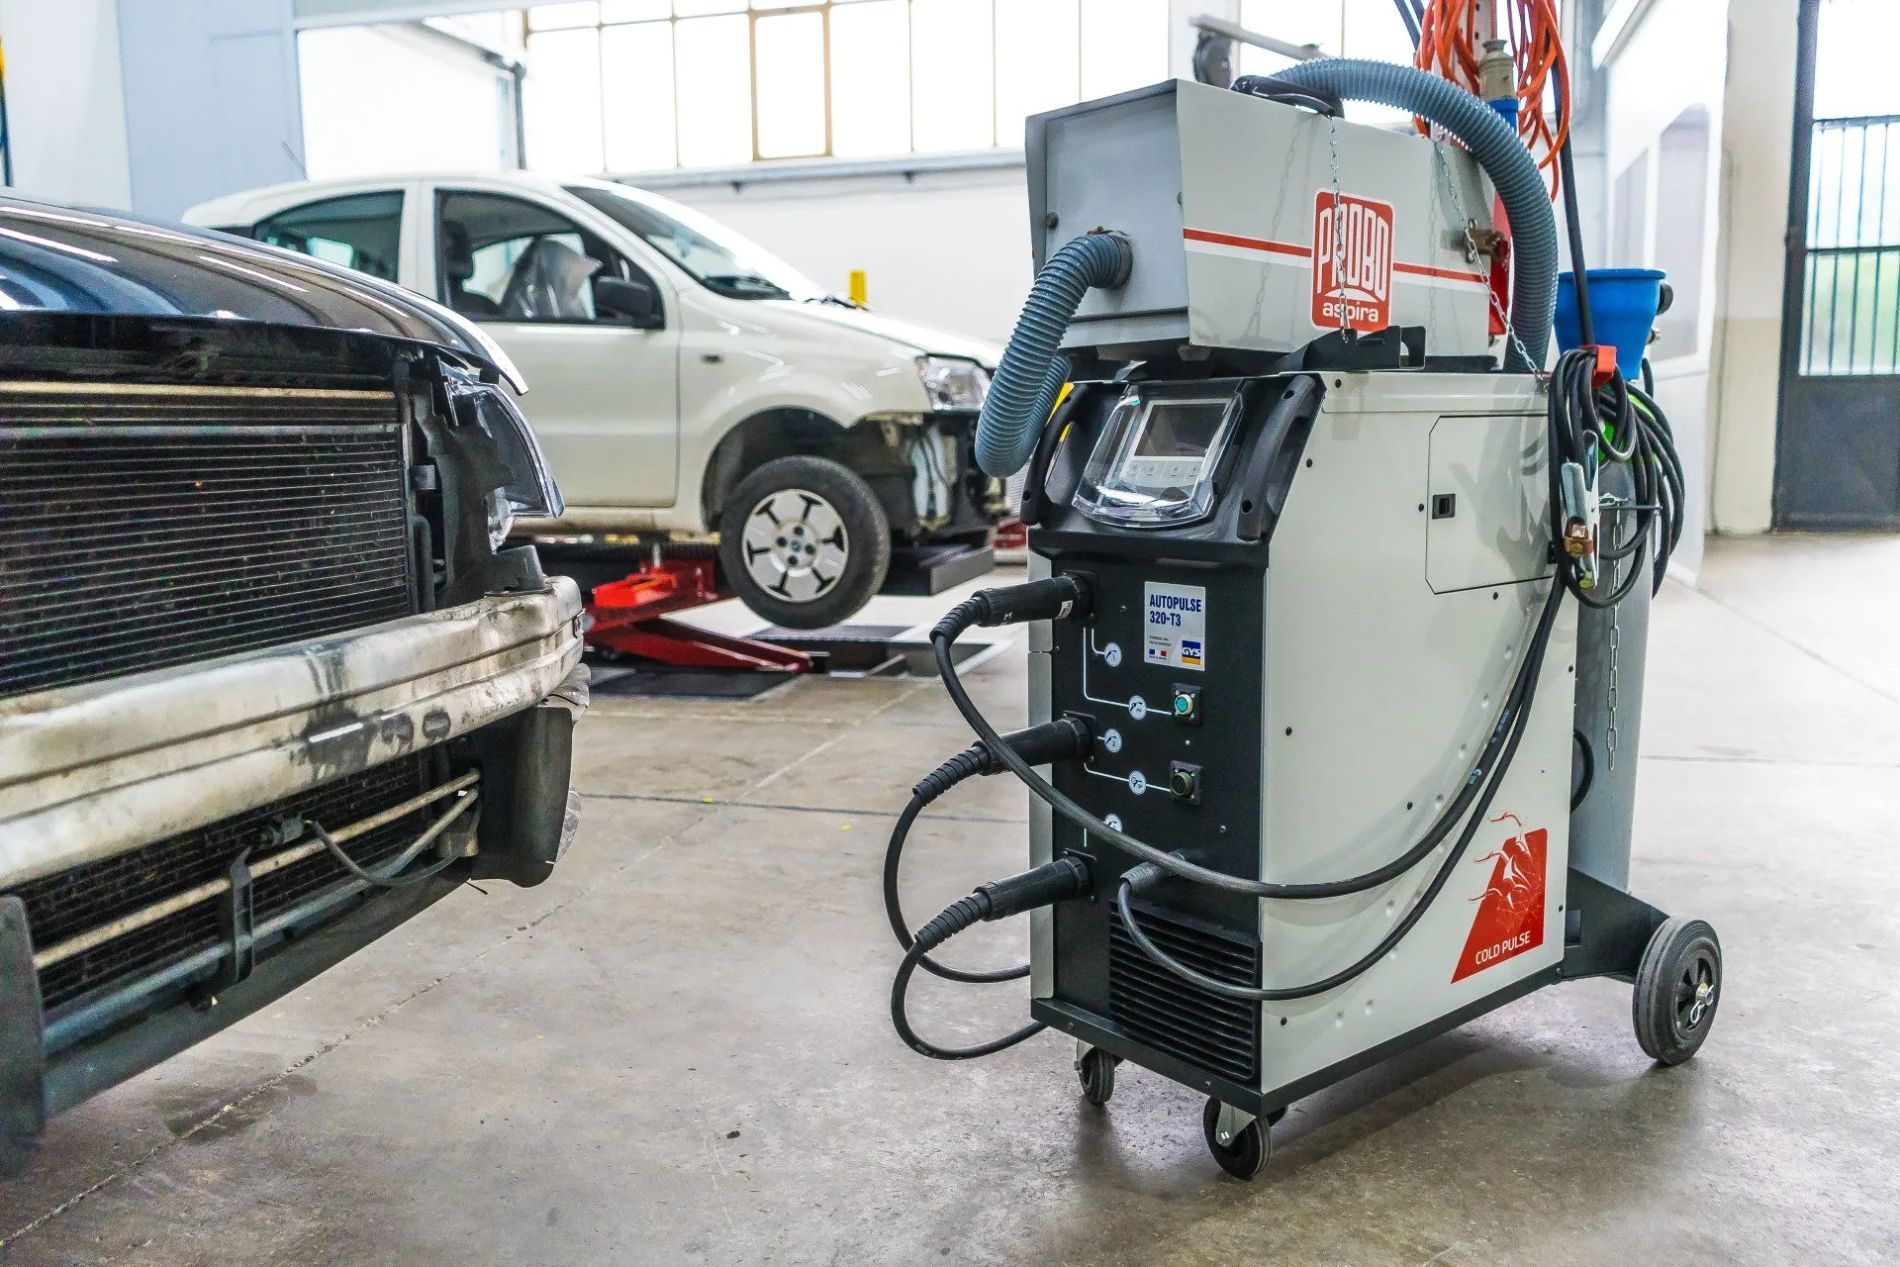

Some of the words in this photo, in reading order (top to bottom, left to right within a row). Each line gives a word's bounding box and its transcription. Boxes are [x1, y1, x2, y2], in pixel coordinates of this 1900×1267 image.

[1317, 203, 1389, 301] PROBO
[1322, 302, 1379, 322] aspira
[1149, 594, 1202, 612] AUTOPULSE
[1149, 611, 1181, 627] 320-T3
[1182, 646, 1201, 657] GYS
[1475, 944, 1500, 965] COLD
[1502, 931, 1531, 954] PULSE
